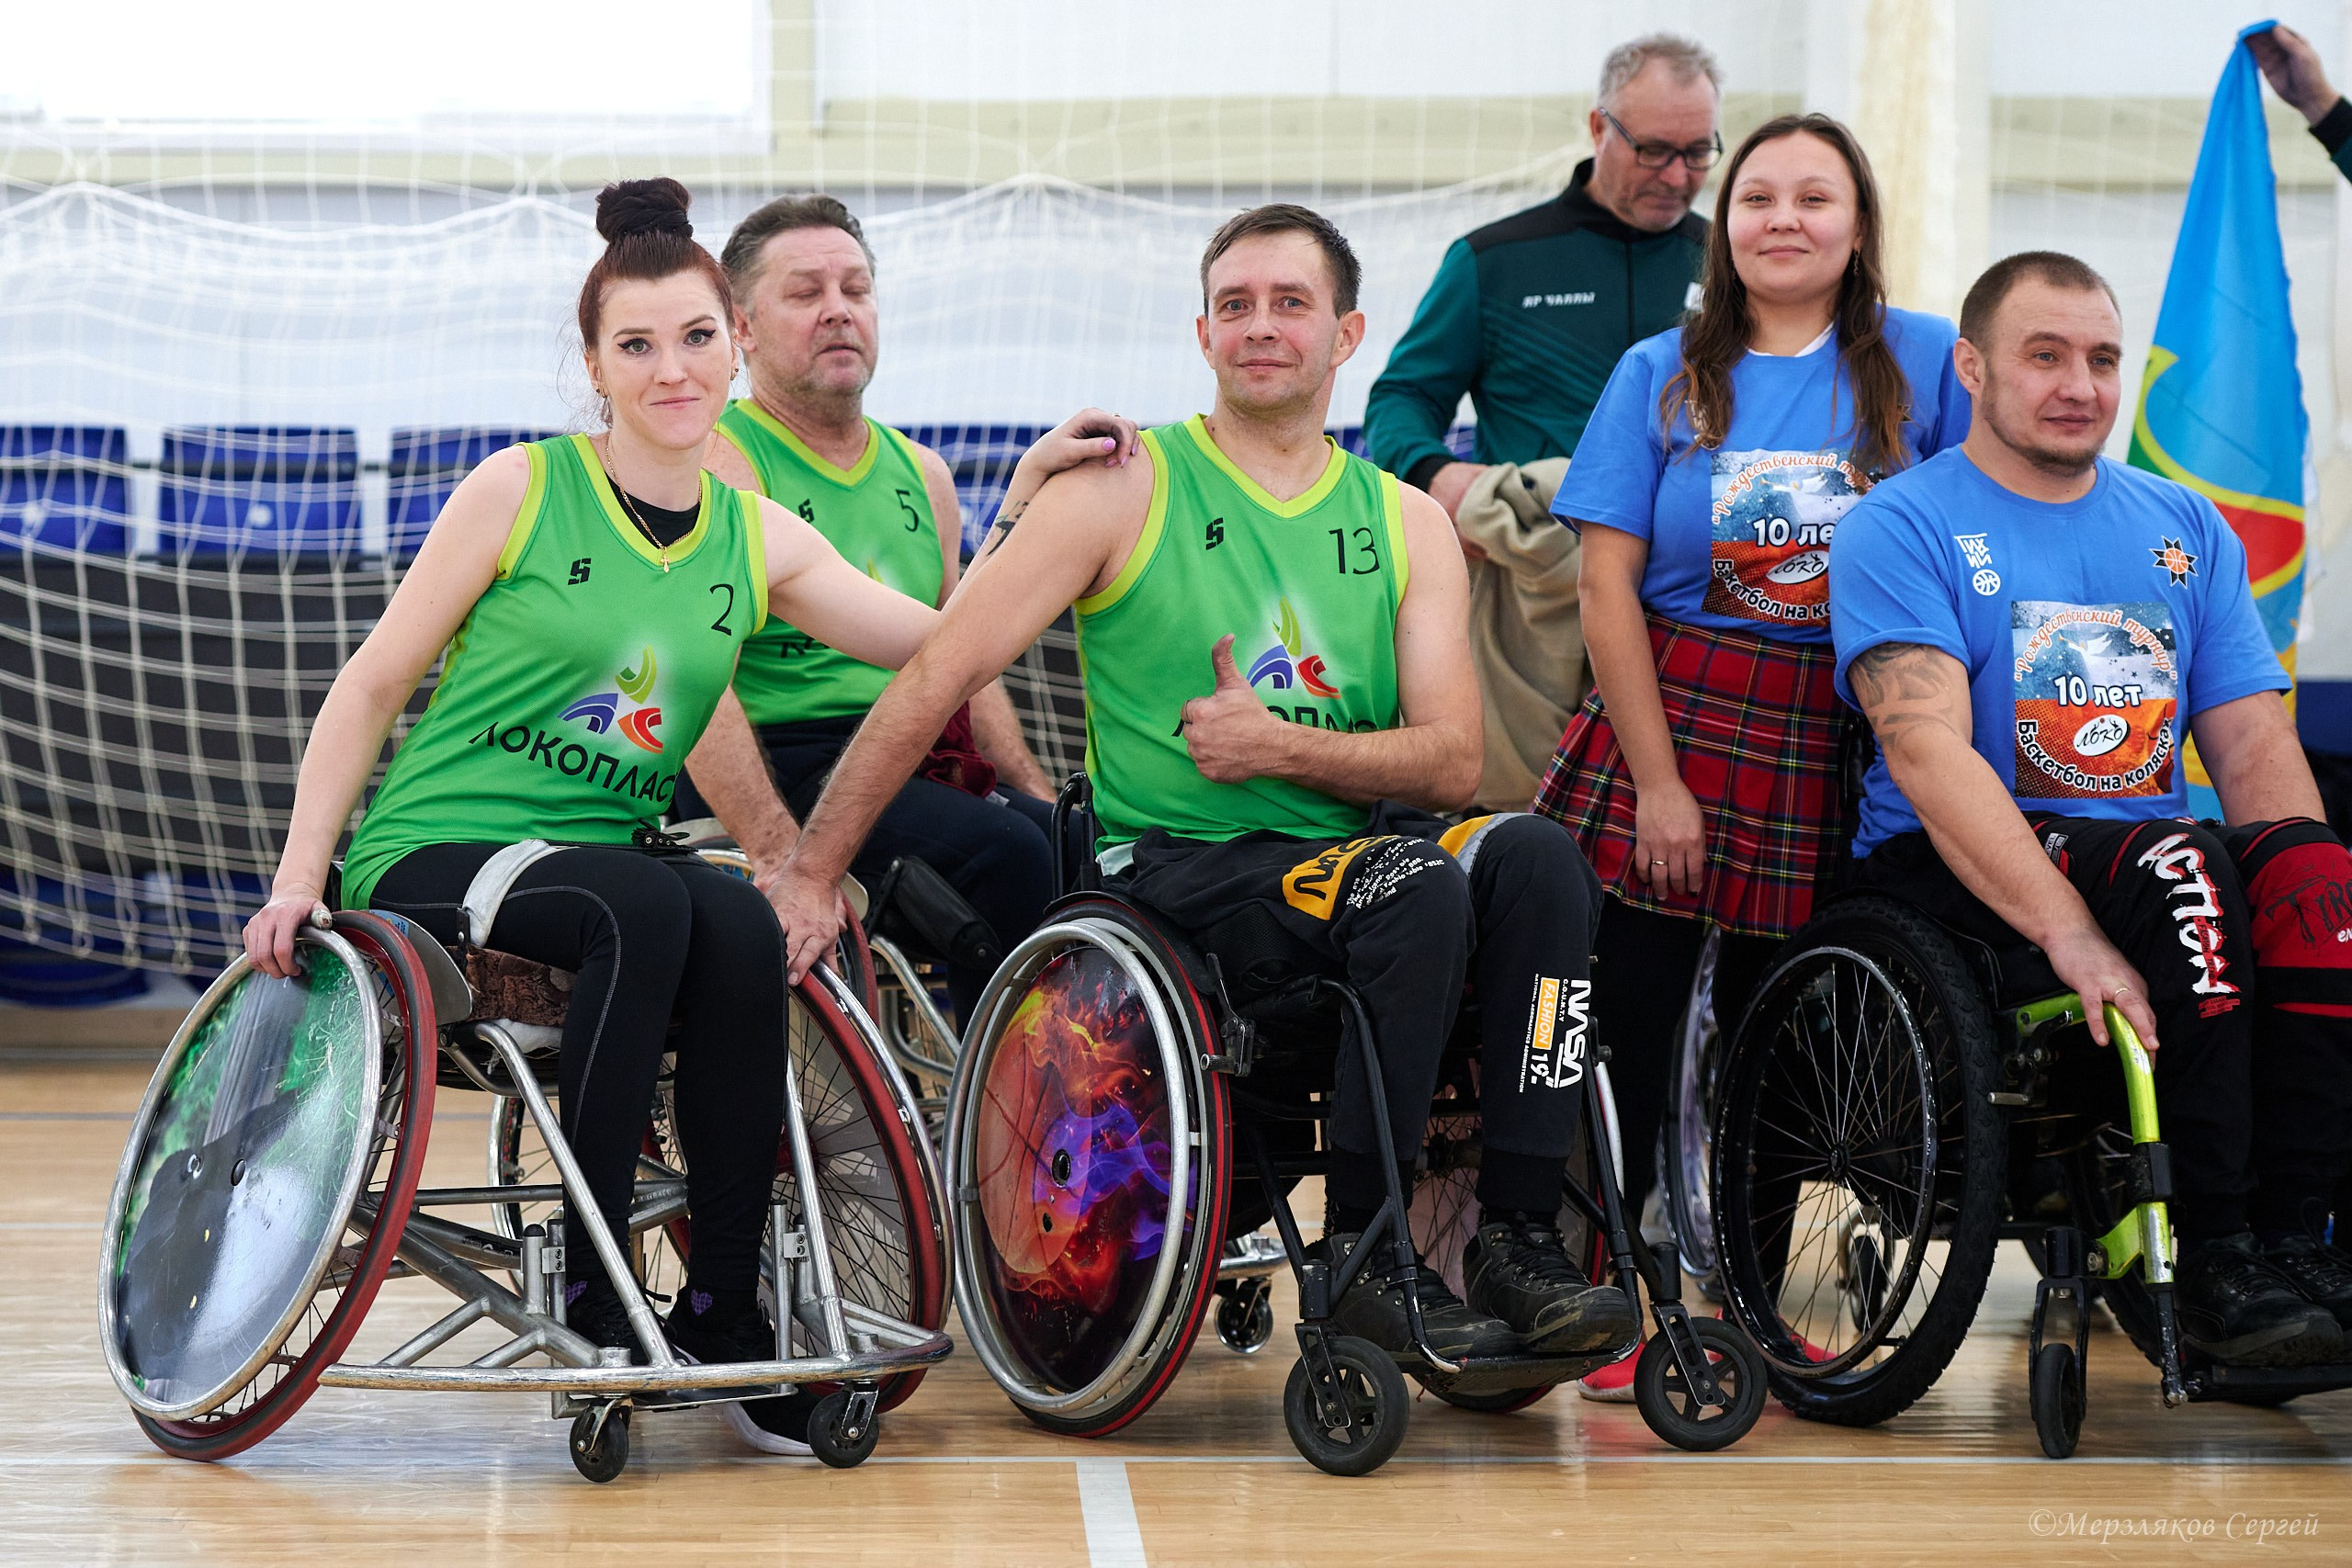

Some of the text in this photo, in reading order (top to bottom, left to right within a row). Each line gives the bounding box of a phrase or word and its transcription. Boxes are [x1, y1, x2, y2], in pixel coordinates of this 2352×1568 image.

[896, 489, 920, 532] 5
[1753, 517, 1791, 547] 10
[1329, 527, 1380, 574] 13
[709, 583, 734, 636] 2
[1784, 604, 1808, 620] на
[2054, 675, 2143, 707] 10 лет
[2018, 717, 2174, 792] Баскетбол на колясках
[2138, 833, 2241, 994] ACTION
[1518, 973, 1540, 1093] NATIONAL AERONAUTICS ADMINISTRATION
[1538, 983, 1555, 1045] FASHION
[1558, 979, 1591, 1089] NASA
